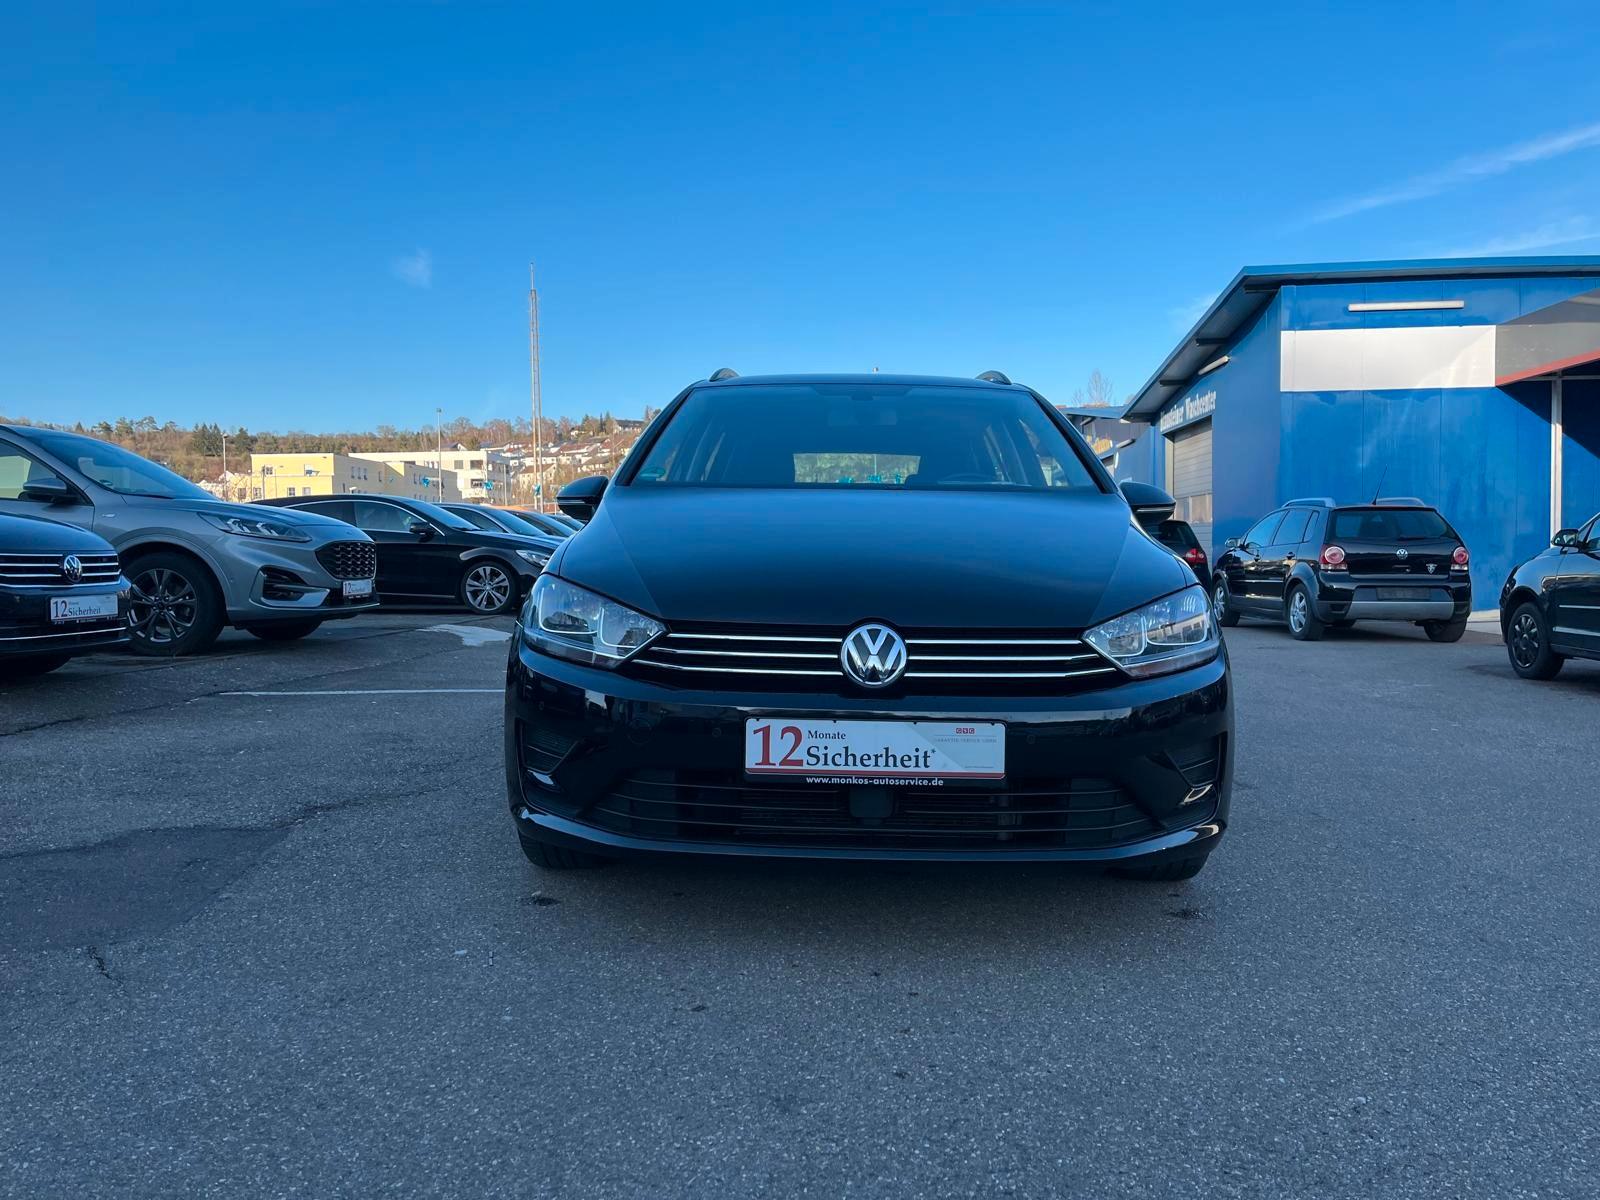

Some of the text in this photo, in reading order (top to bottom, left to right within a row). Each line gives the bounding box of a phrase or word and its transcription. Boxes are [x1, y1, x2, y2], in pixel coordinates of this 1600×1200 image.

[53, 600, 68, 618] 12
[808, 730, 846, 741] Monate
[753, 725, 804, 767] 12
[806, 777, 944, 787] www.monkos-autoservice.de
